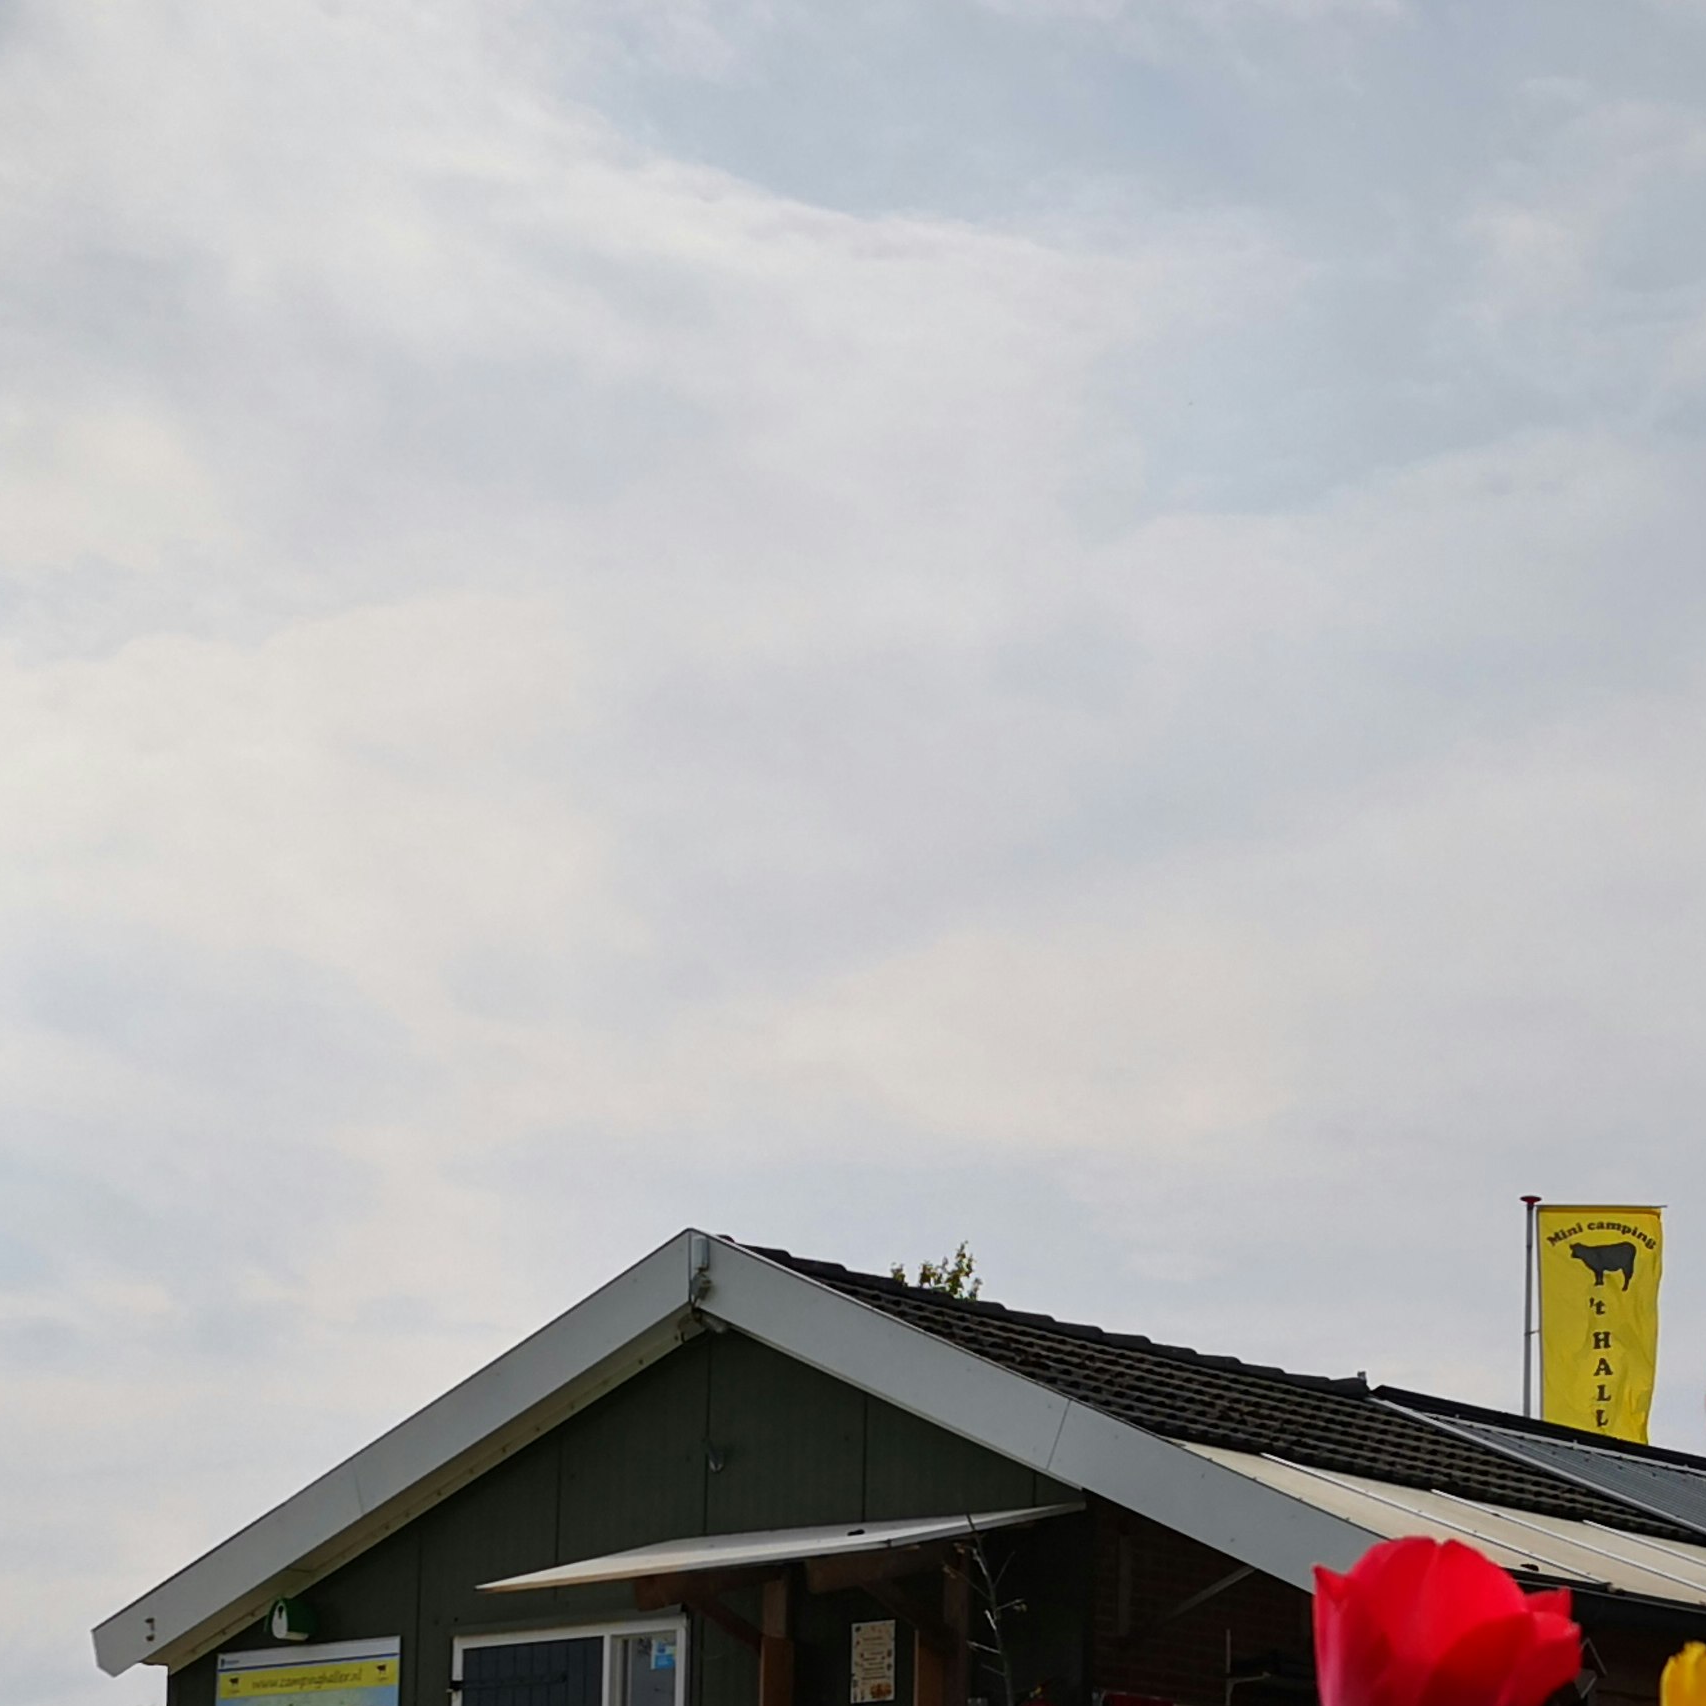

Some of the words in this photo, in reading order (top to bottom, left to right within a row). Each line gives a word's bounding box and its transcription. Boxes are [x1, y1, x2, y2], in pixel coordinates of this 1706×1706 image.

[1546, 1222, 1583, 1247] Mini
[1587, 1221, 1656, 1250] camping
[1589, 1297, 1606, 1315] 't
